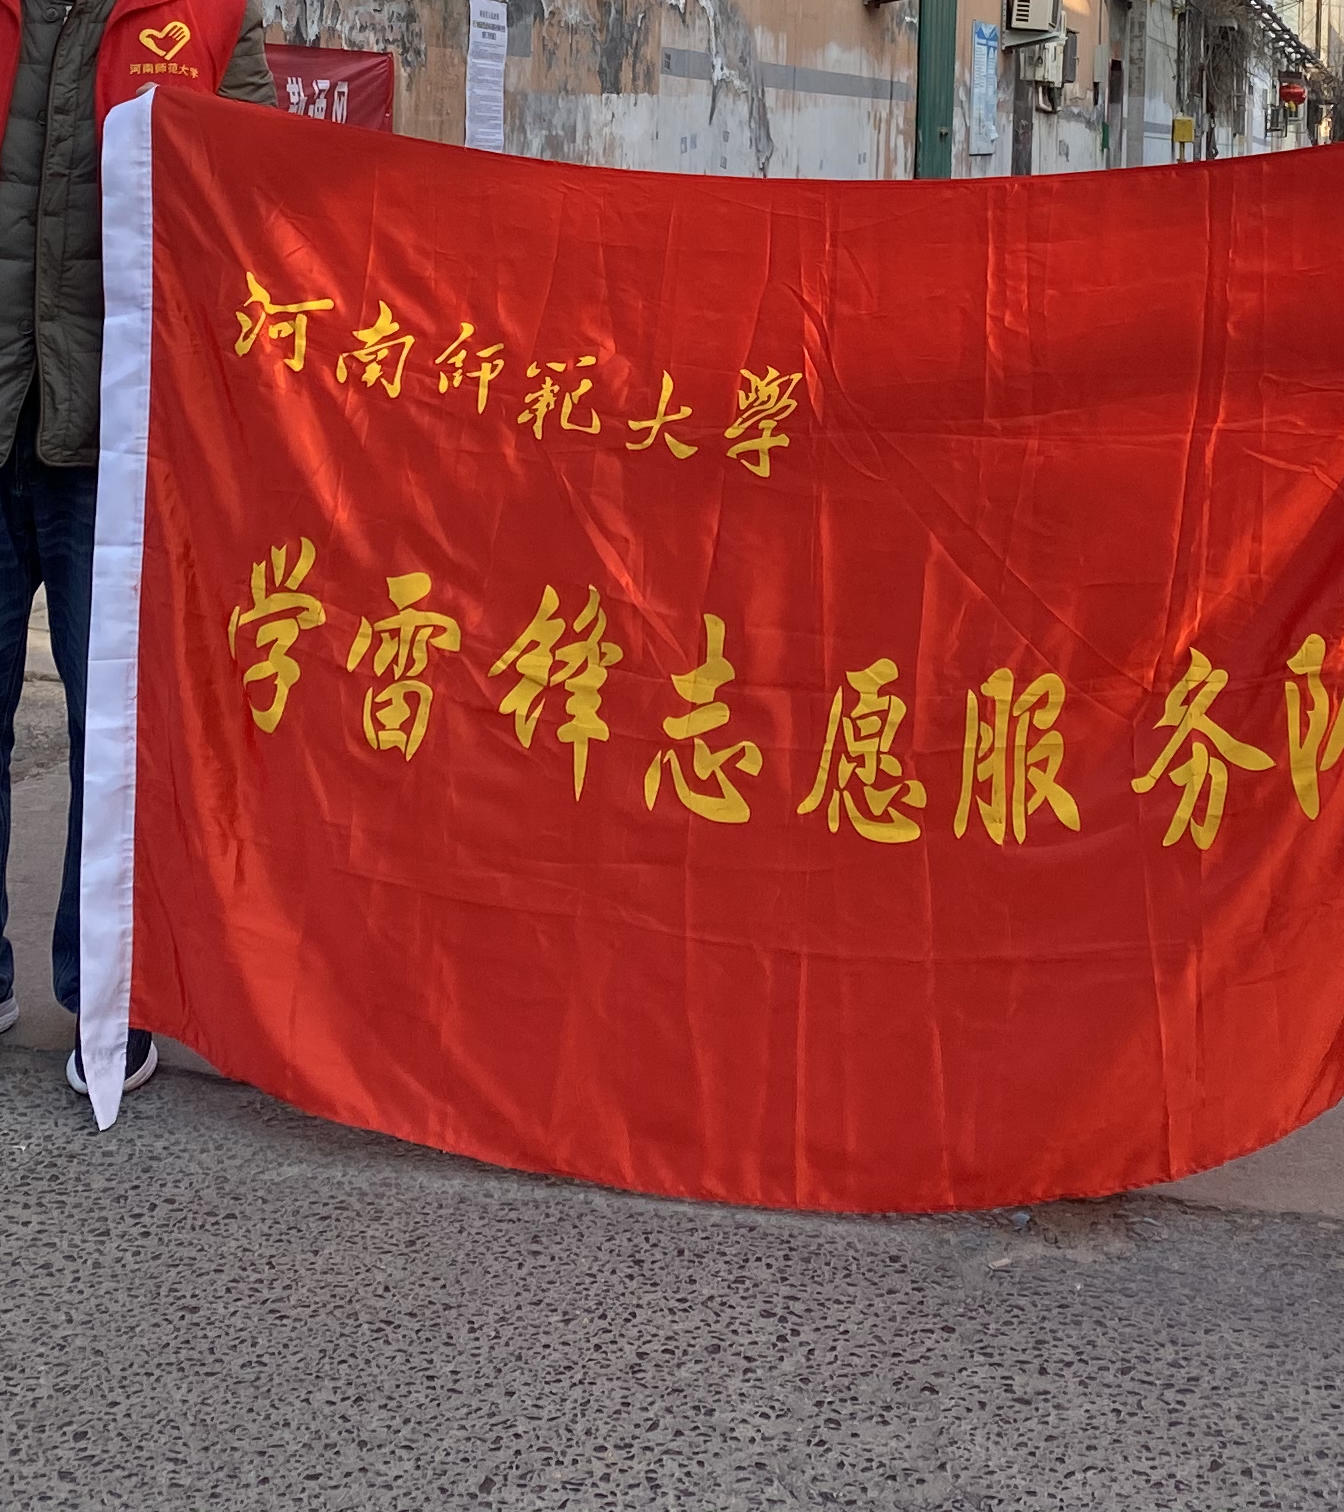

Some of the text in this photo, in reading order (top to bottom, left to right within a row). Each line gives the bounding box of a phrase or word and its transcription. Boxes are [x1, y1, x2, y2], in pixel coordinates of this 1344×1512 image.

[129, 62, 199, 79] 河南师范大学
